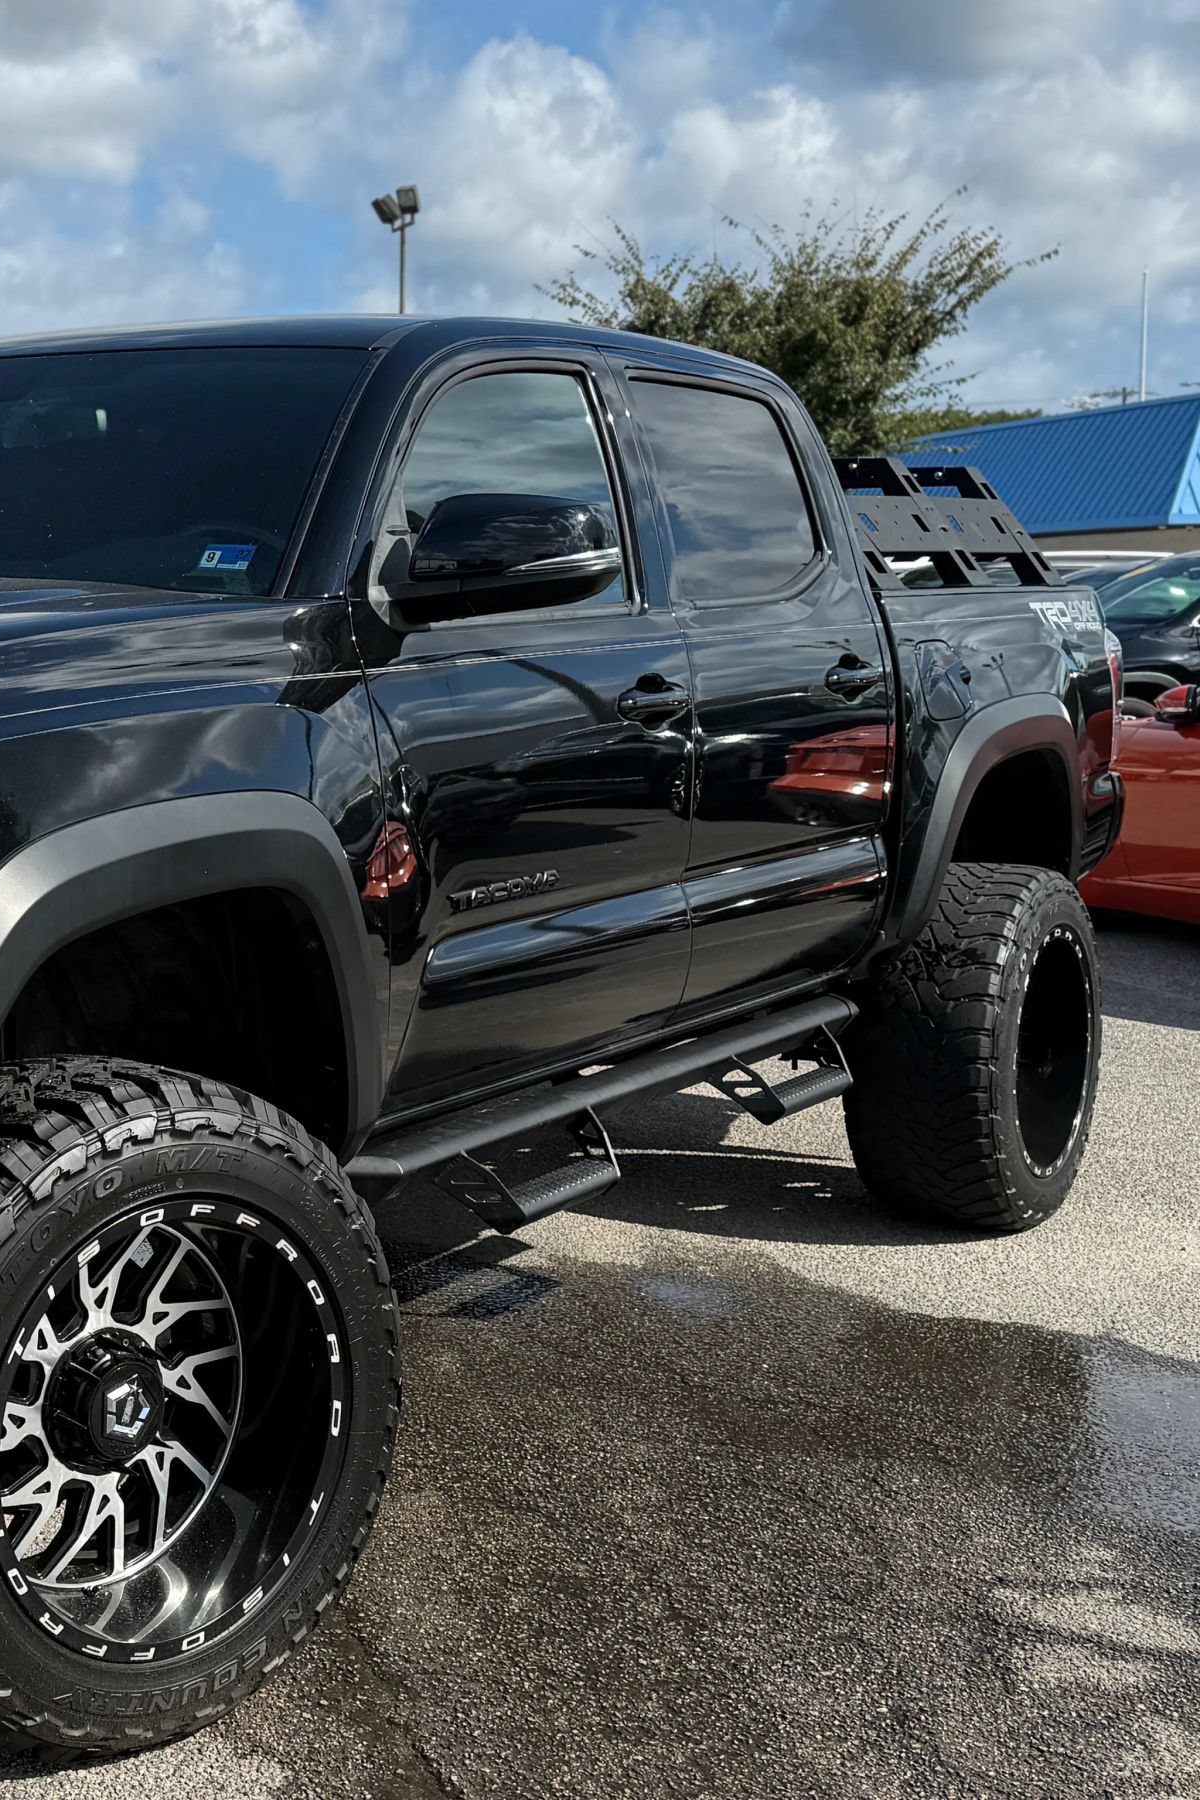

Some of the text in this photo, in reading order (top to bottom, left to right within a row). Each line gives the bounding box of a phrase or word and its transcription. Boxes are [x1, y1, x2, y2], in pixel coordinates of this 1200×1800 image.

[204, 551, 217, 563] 9
[1029, 601, 1072, 632] TRD
[446, 869, 560, 912] TACOMA
[0, 1165, 124, 1286] TOYO
[155, 1146, 242, 1177] M/T
